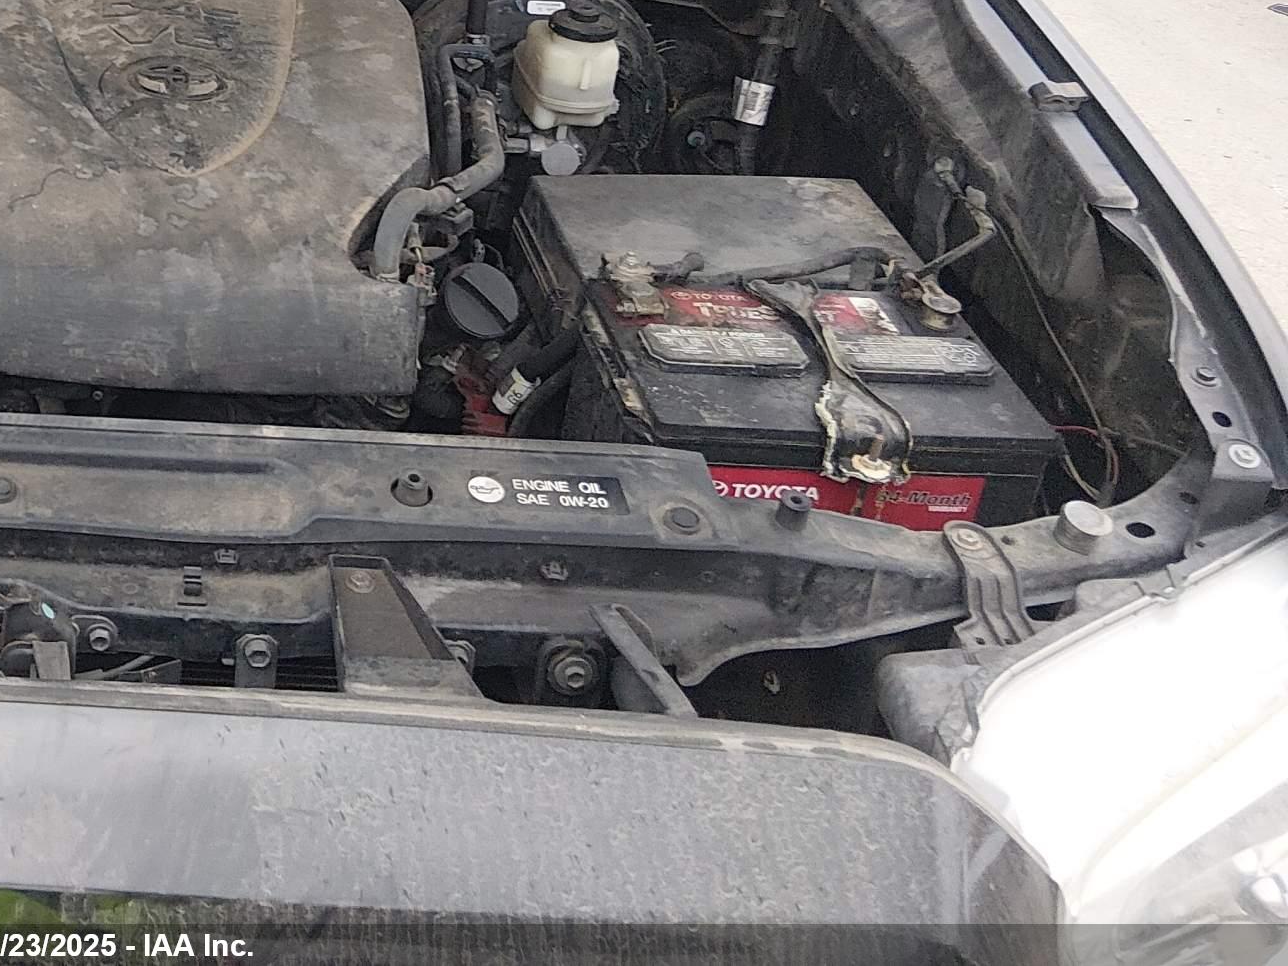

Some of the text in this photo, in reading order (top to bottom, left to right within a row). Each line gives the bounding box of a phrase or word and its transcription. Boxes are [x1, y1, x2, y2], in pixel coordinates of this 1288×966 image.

[511, 478, 607, 495] ENGINE OIL
[732, 483, 820, 501] TOYOTA
[515, 493, 610, 509] SAE 0W-20
